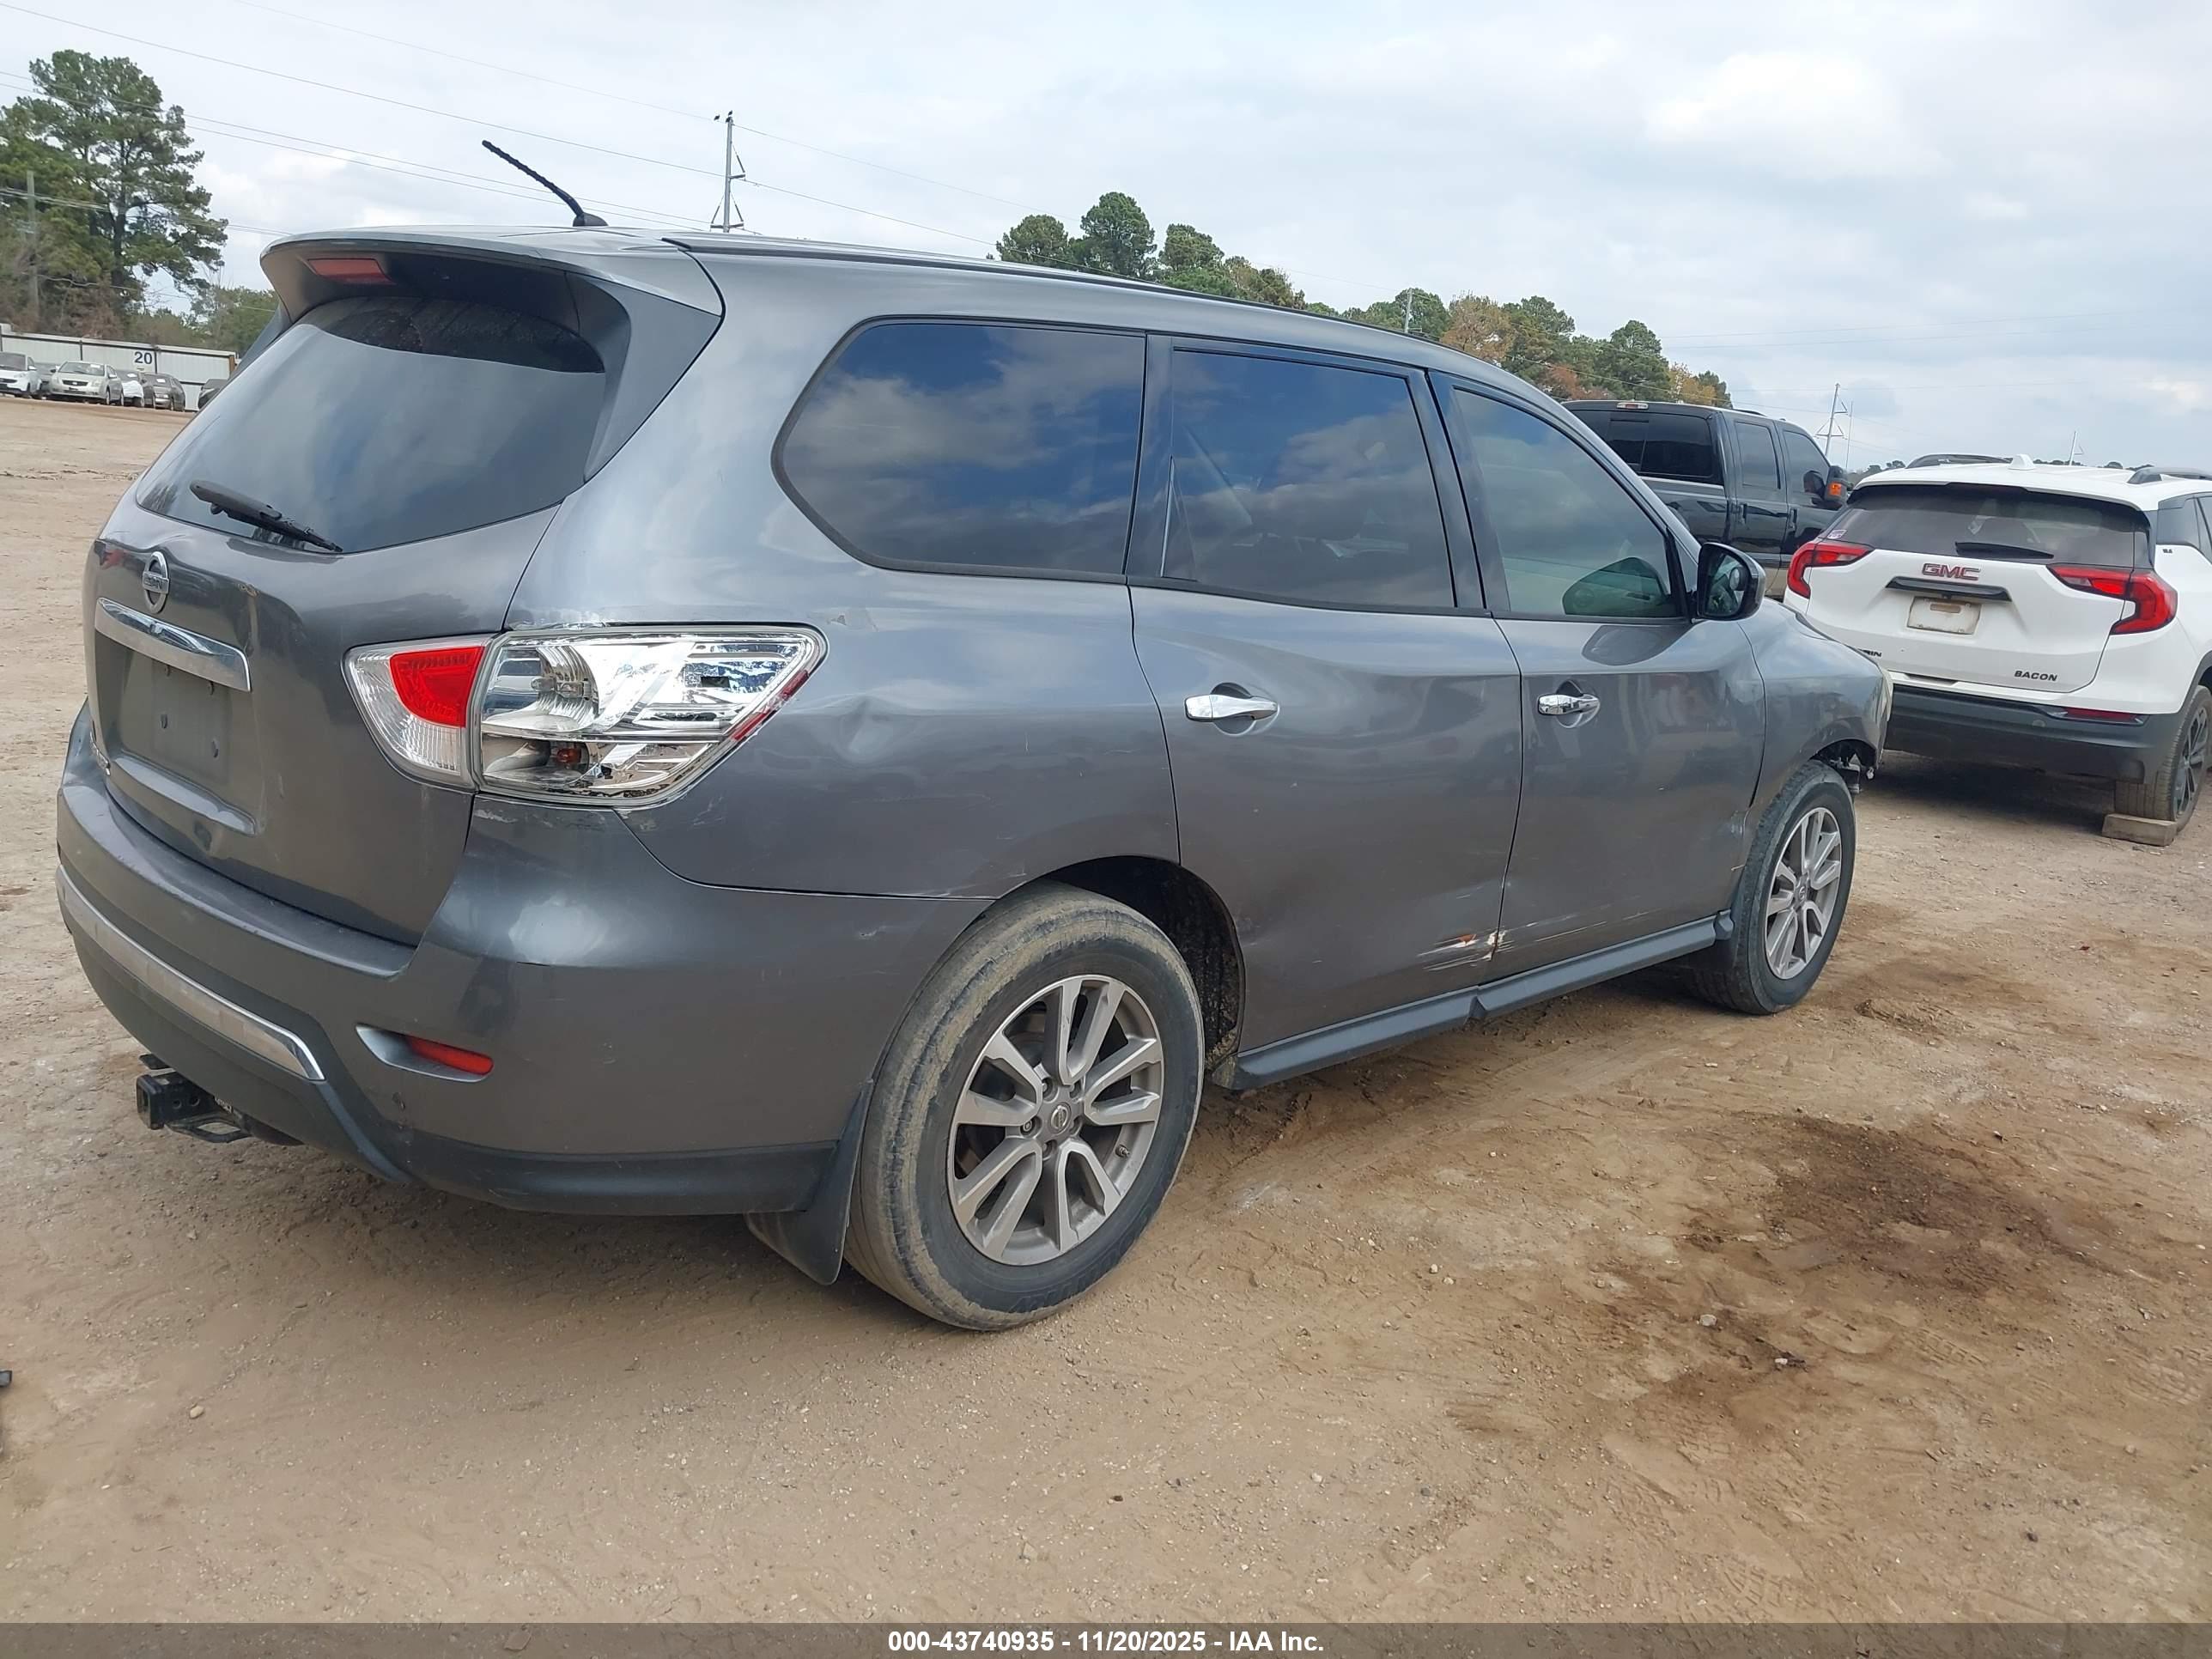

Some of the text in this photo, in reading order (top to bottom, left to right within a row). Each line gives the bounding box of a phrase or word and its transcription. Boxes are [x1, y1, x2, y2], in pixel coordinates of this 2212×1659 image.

[134, 350, 153, 365] 20
[1923, 562, 1981, 581] GMC
[2014, 670, 2058, 682] BACON
